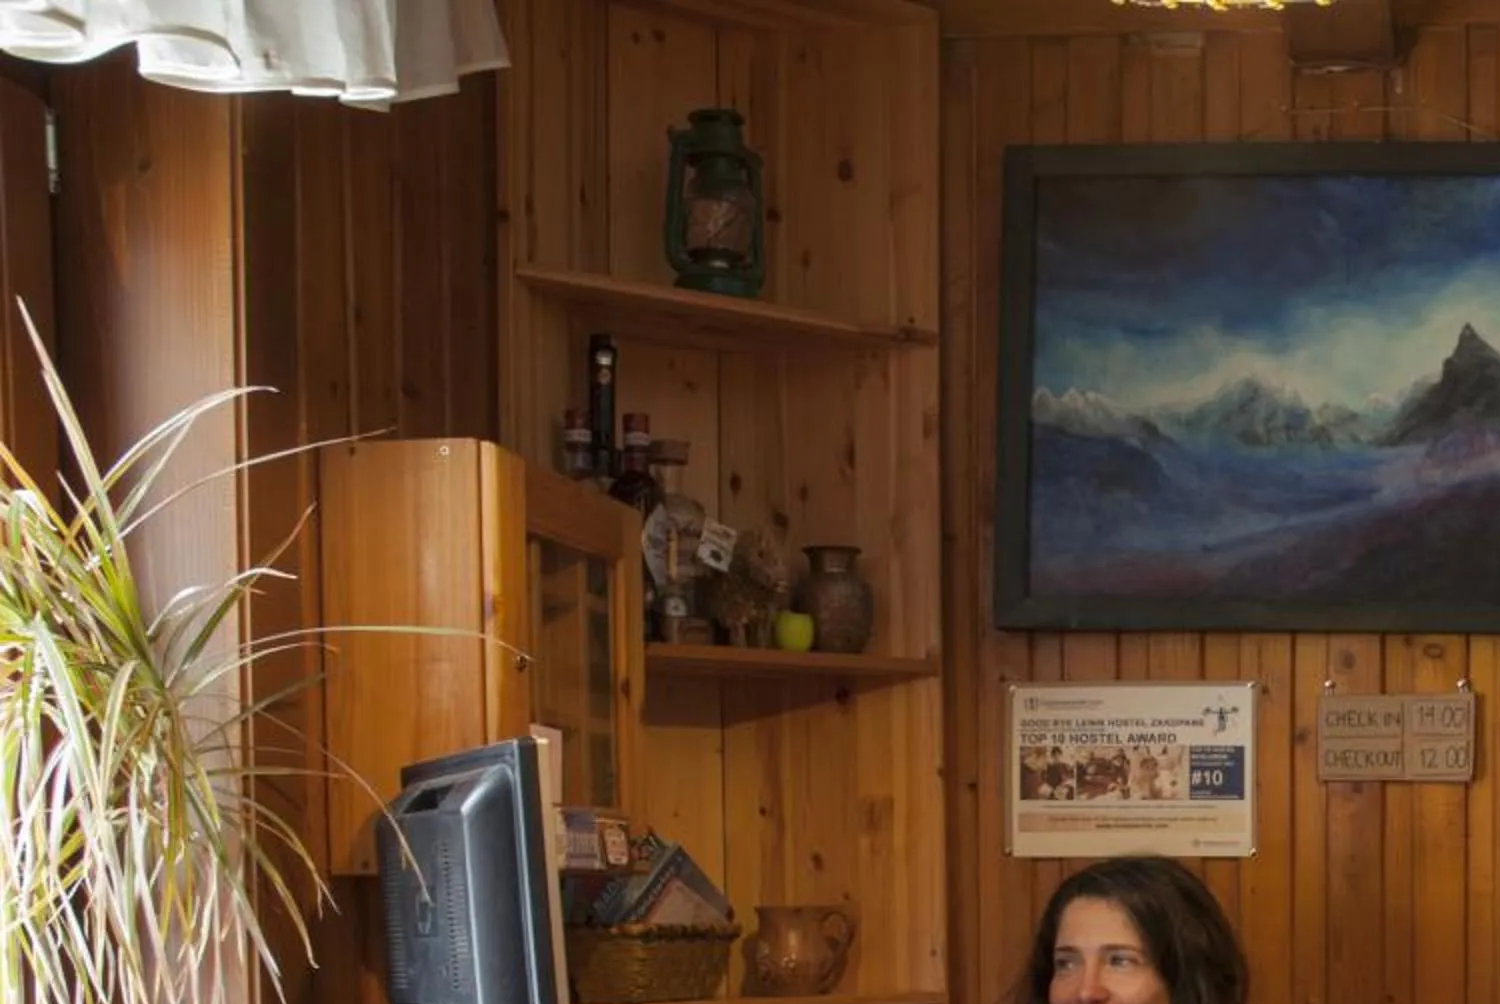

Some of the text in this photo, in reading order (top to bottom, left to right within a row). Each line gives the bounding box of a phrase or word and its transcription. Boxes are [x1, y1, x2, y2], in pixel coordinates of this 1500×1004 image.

[1107, 718, 1146, 728] HOSTEL
[1325, 709, 1378, 729] CHECK
[1382, 710, 1401, 728] IN
[1020, 732, 1177, 745] TOP 10 HOSTEL AWARD
[1191, 768, 1224, 787] #10
